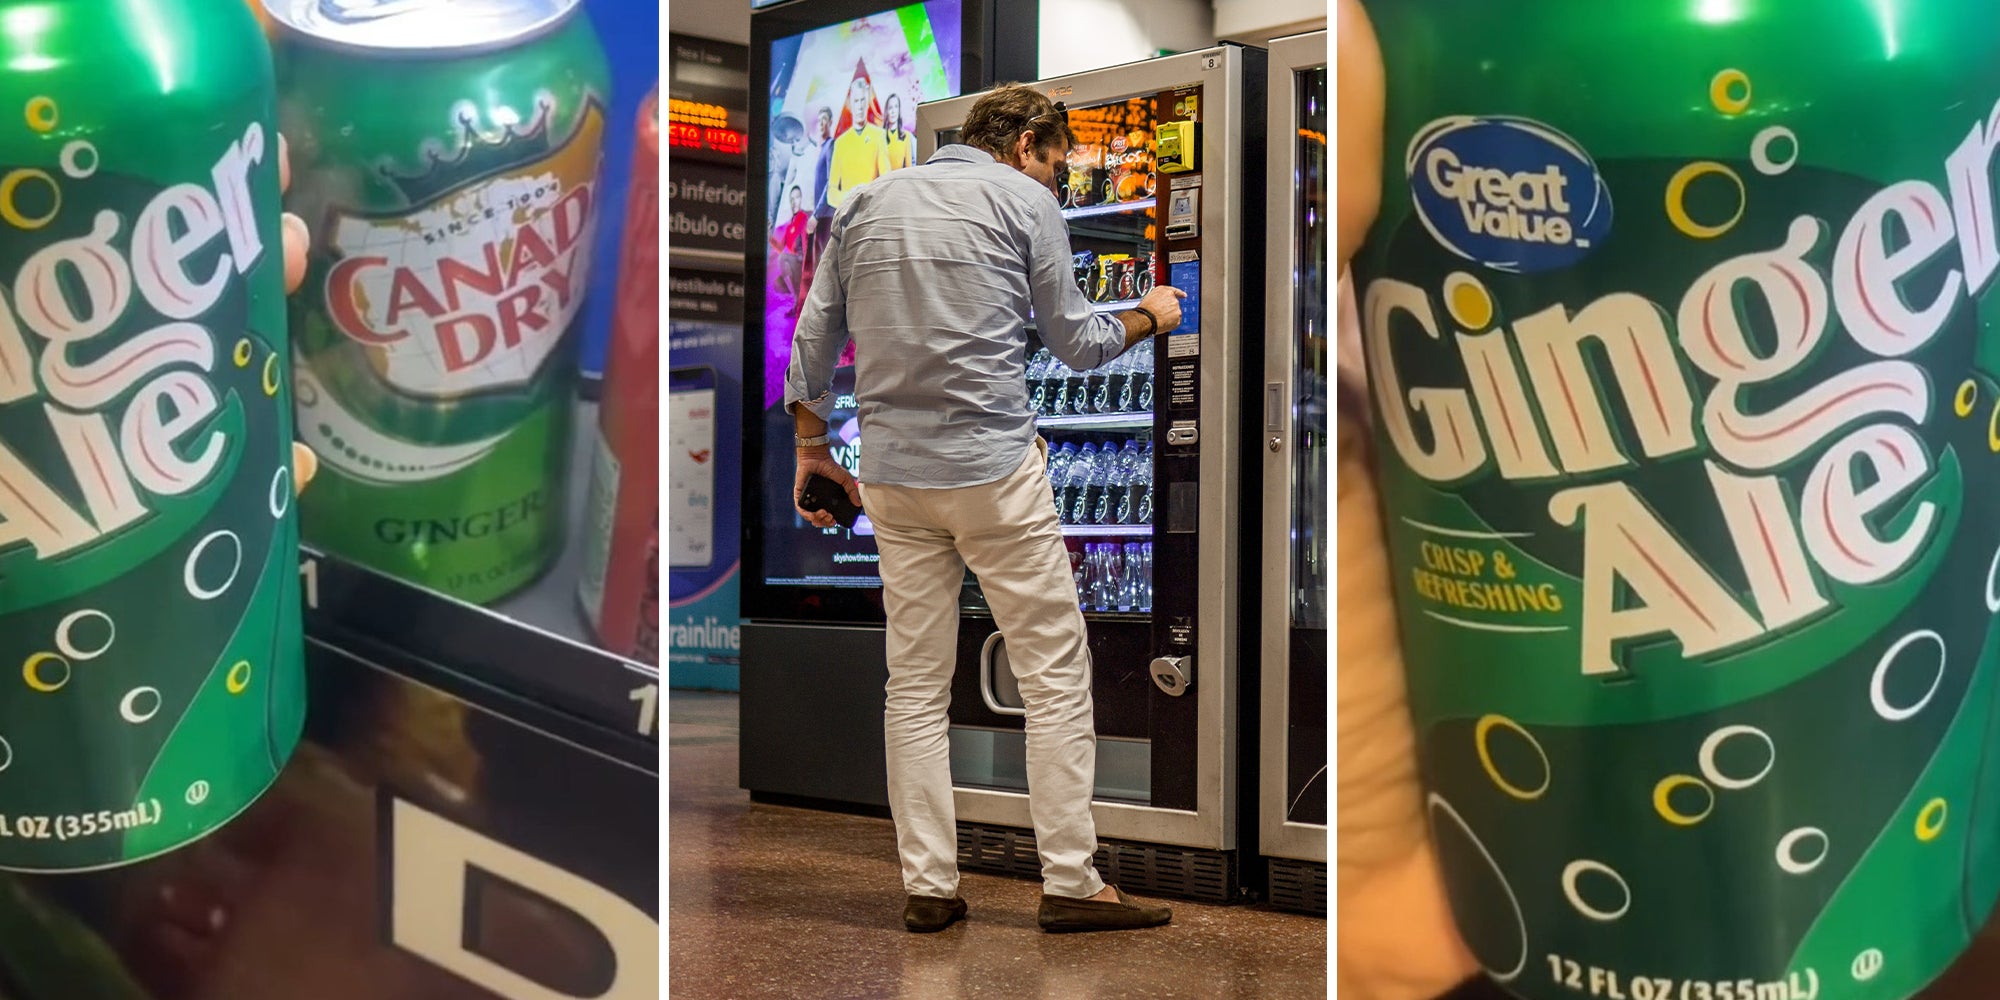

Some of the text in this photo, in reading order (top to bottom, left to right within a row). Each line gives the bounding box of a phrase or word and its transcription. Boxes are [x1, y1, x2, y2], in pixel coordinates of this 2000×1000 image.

[1208, 58, 1215, 68] 8
[681, 178, 747, 206] inferior
[1427, 148, 1569, 213] Great
[423, 207, 495, 245] SINCE
[1460, 195, 1573, 246] Value
[0, 122, 264, 410] ger
[434, 247, 580, 373] DRY
[374, 489, 547, 545] GINGER
[1421, 541, 1515, 578] CRISP &
[1548, 423, 1936, 675] Ale
[1413, 566, 1562, 613] REFRESHING
[16, 816, 51, 839] OZ
[54, 798, 162, 841] (355mL)
[1546, 953, 1584, 989] 12
[1590, 967, 1625, 1000] FL
[1630, 976, 1673, 1000] OZ
